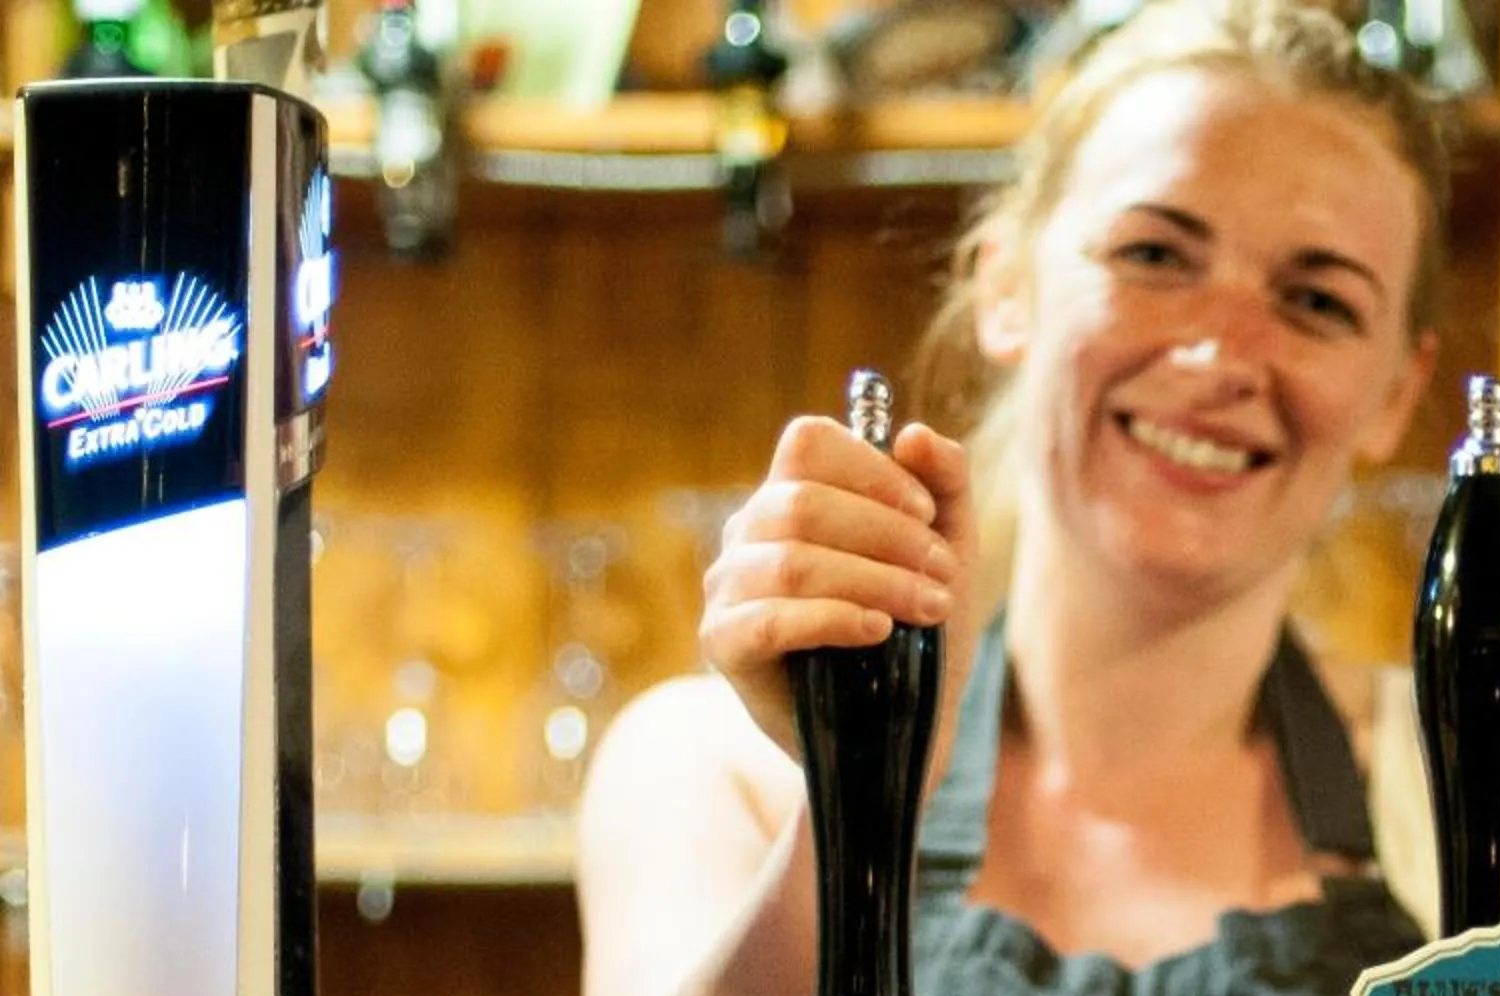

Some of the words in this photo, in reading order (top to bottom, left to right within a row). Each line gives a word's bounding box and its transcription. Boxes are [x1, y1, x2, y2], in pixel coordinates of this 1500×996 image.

[42, 316, 239, 409] CARLING
[68, 423, 139, 460] EXTRA
[142, 402, 207, 439] COLD
